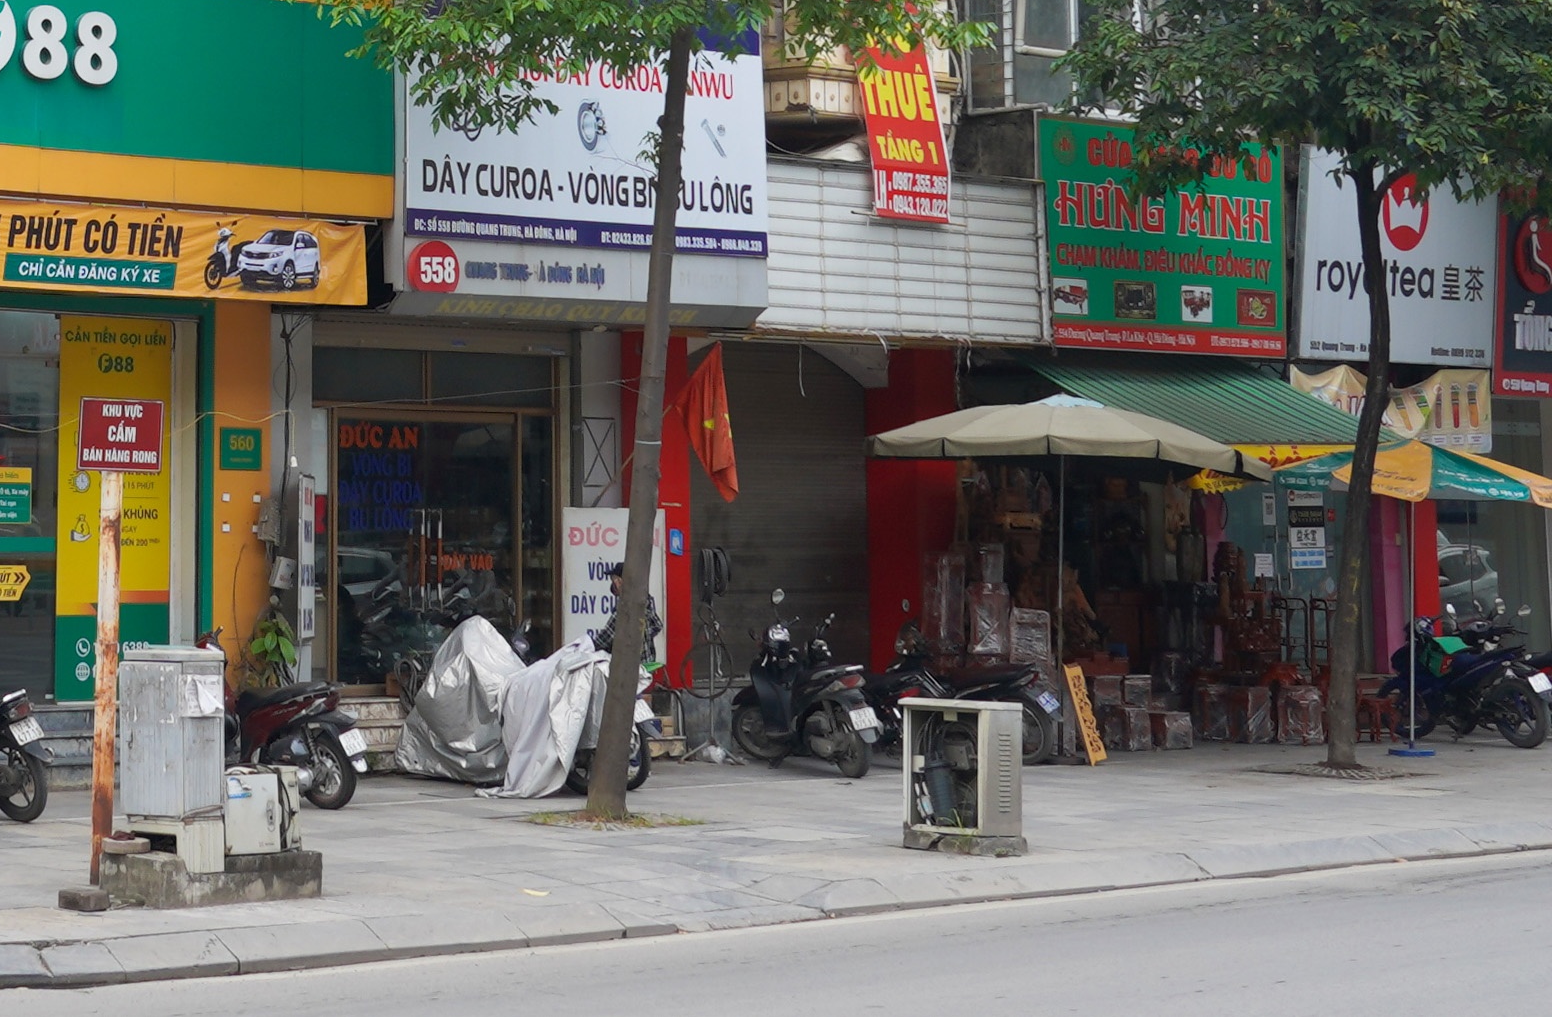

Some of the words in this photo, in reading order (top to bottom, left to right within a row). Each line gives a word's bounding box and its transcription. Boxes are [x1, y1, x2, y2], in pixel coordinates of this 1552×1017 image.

[859, 63, 936, 122] THUÊ
[876, 128, 925, 165] TẦNG
[928, 141, 940, 165] 1
[422, 155, 471, 196] DÂY
[476, 163, 555, 202] CUROA
[568, 166, 630, 209] VÒNG
[699, 174, 753, 216] LÔNG
[1054, 177, 1166, 235] HƯNG
[1177, 191, 1272, 244] MINH
[7, 210, 78, 251] PHÚT
[83, 214, 119, 255] CÓ
[128, 213, 184, 259] TIỀN
[18, 257, 45, 277] CHỈ
[78, 262, 117, 282] ĐĂNG
[121, 264, 141, 282] KÝ
[142, 269, 161, 283] XE
[1056, 242, 1097, 272] CHẠM
[420, 256, 456, 285] 558
[1441, 263, 1485, 302] 皇茶
[120, 332, 142, 349] GỌI
[98, 352, 134, 374] F88
[102, 403, 122, 417] KHU
[124, 404, 144, 421] VỰC
[107, 420, 137, 444] CẤM
[229, 435, 255, 451] 560
[339, 421, 384, 449] ĐỨC
[388, 426, 420, 450] AN
[83, 445, 104, 462] BÁN
[104, 446, 130, 464] HÀNG
[132, 450, 158, 465] RONG
[123, 505, 159, 521] KHỦNG
[568, 521, 619, 547] ĐỨC
[571, 590, 596, 615] DÂY
